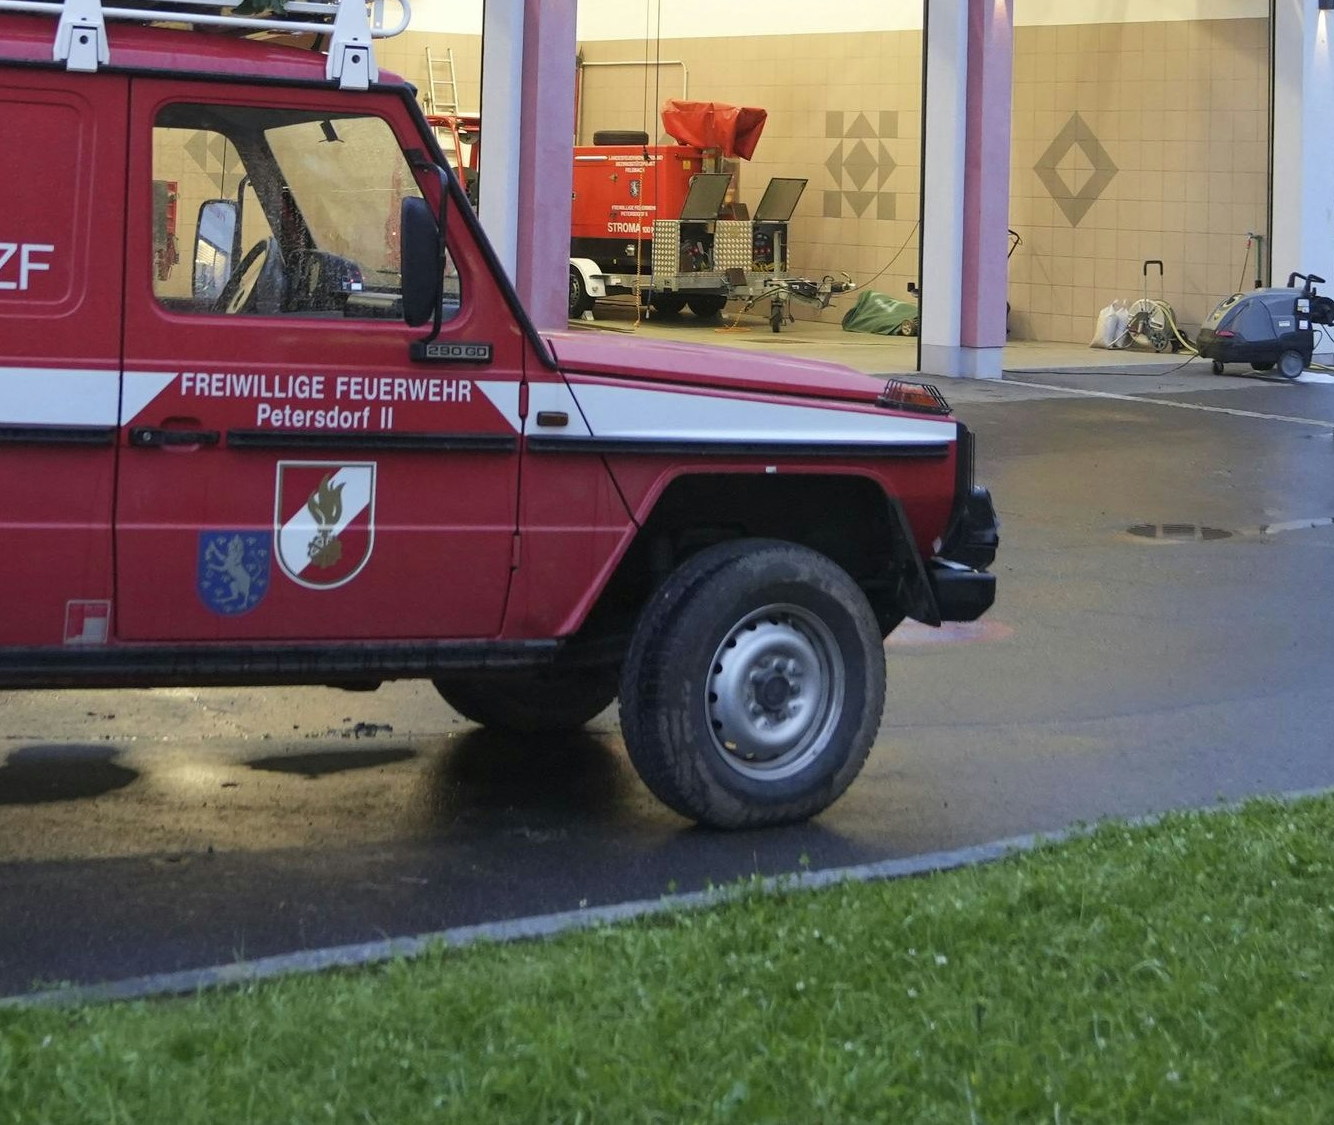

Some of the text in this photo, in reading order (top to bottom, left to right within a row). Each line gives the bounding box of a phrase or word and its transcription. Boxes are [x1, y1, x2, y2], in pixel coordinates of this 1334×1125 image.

[607, 222, 641, 233] STROMA
[428, 346, 462, 356] 290
[180, 372, 472, 402] FREIWILLIGE FEUERWEHR
[256, 403, 370, 428] Petersdorf
